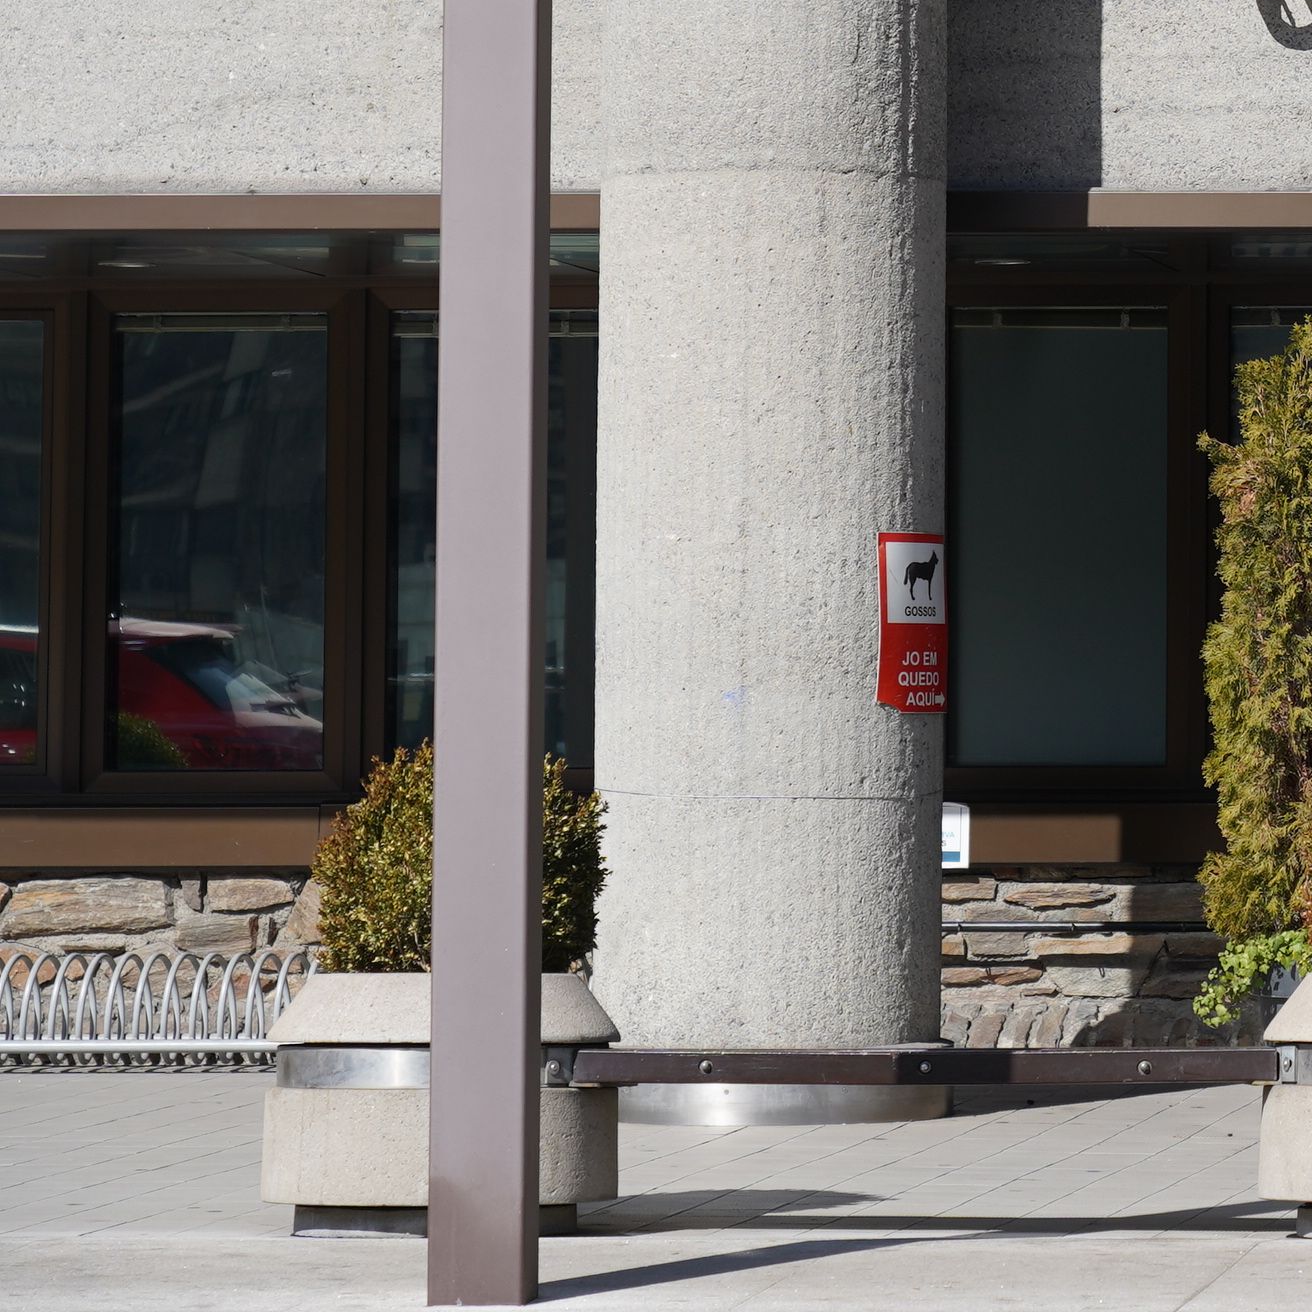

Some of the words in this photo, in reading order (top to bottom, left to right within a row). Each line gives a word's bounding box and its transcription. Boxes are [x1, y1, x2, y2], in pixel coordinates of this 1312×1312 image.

[905, 606, 937, 617] GOSSOS
[902, 651, 920, 666] JO
[923, 651, 937, 666] EM
[898, 671, 939, 687] QUEDO
[906, 688, 935, 706] AQUÍ
